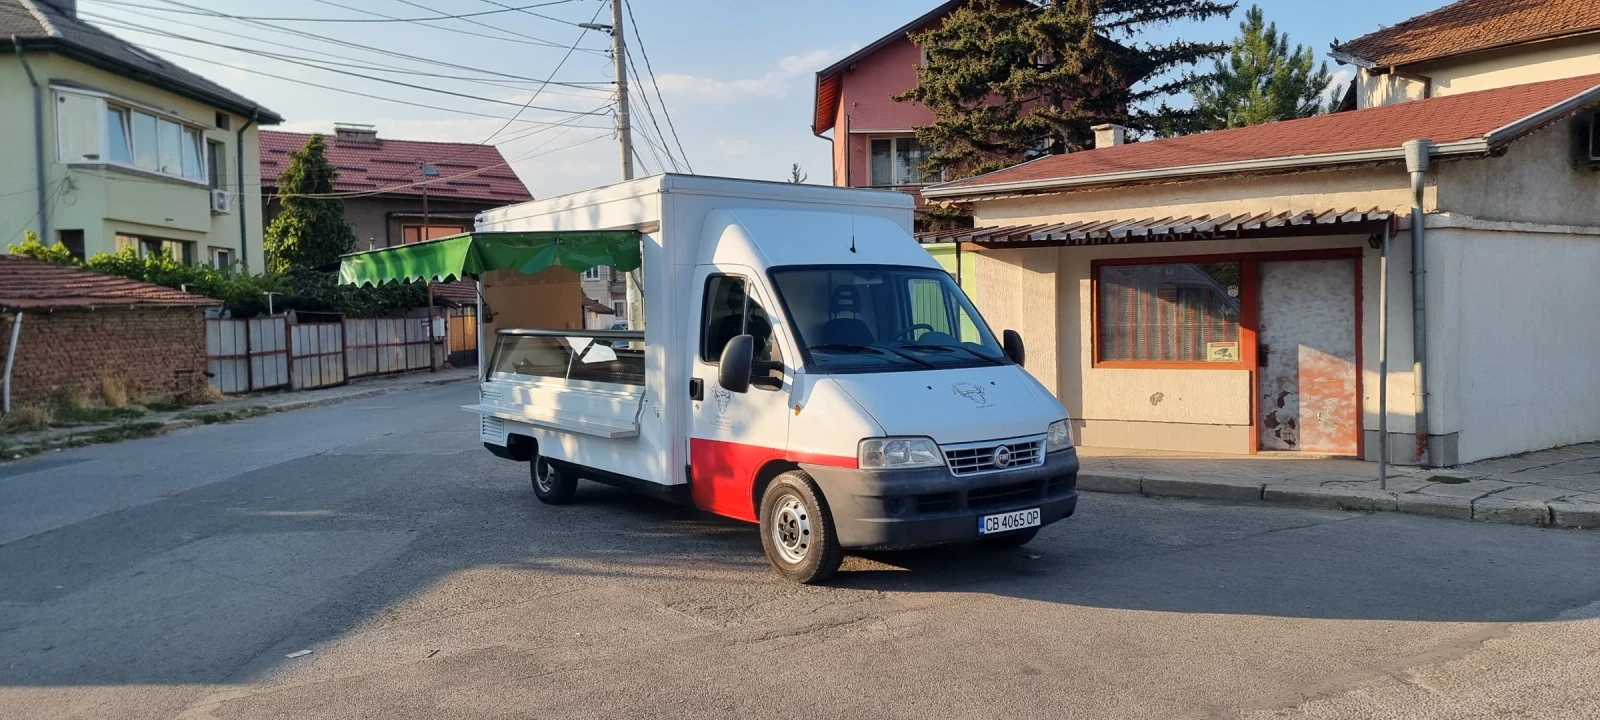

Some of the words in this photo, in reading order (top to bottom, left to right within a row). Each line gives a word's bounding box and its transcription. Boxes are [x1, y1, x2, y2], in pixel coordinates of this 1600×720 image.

[986, 517, 999, 531] CB
[1001, 513, 1025, 529] 4065
[1027, 511, 1039, 525] OP
